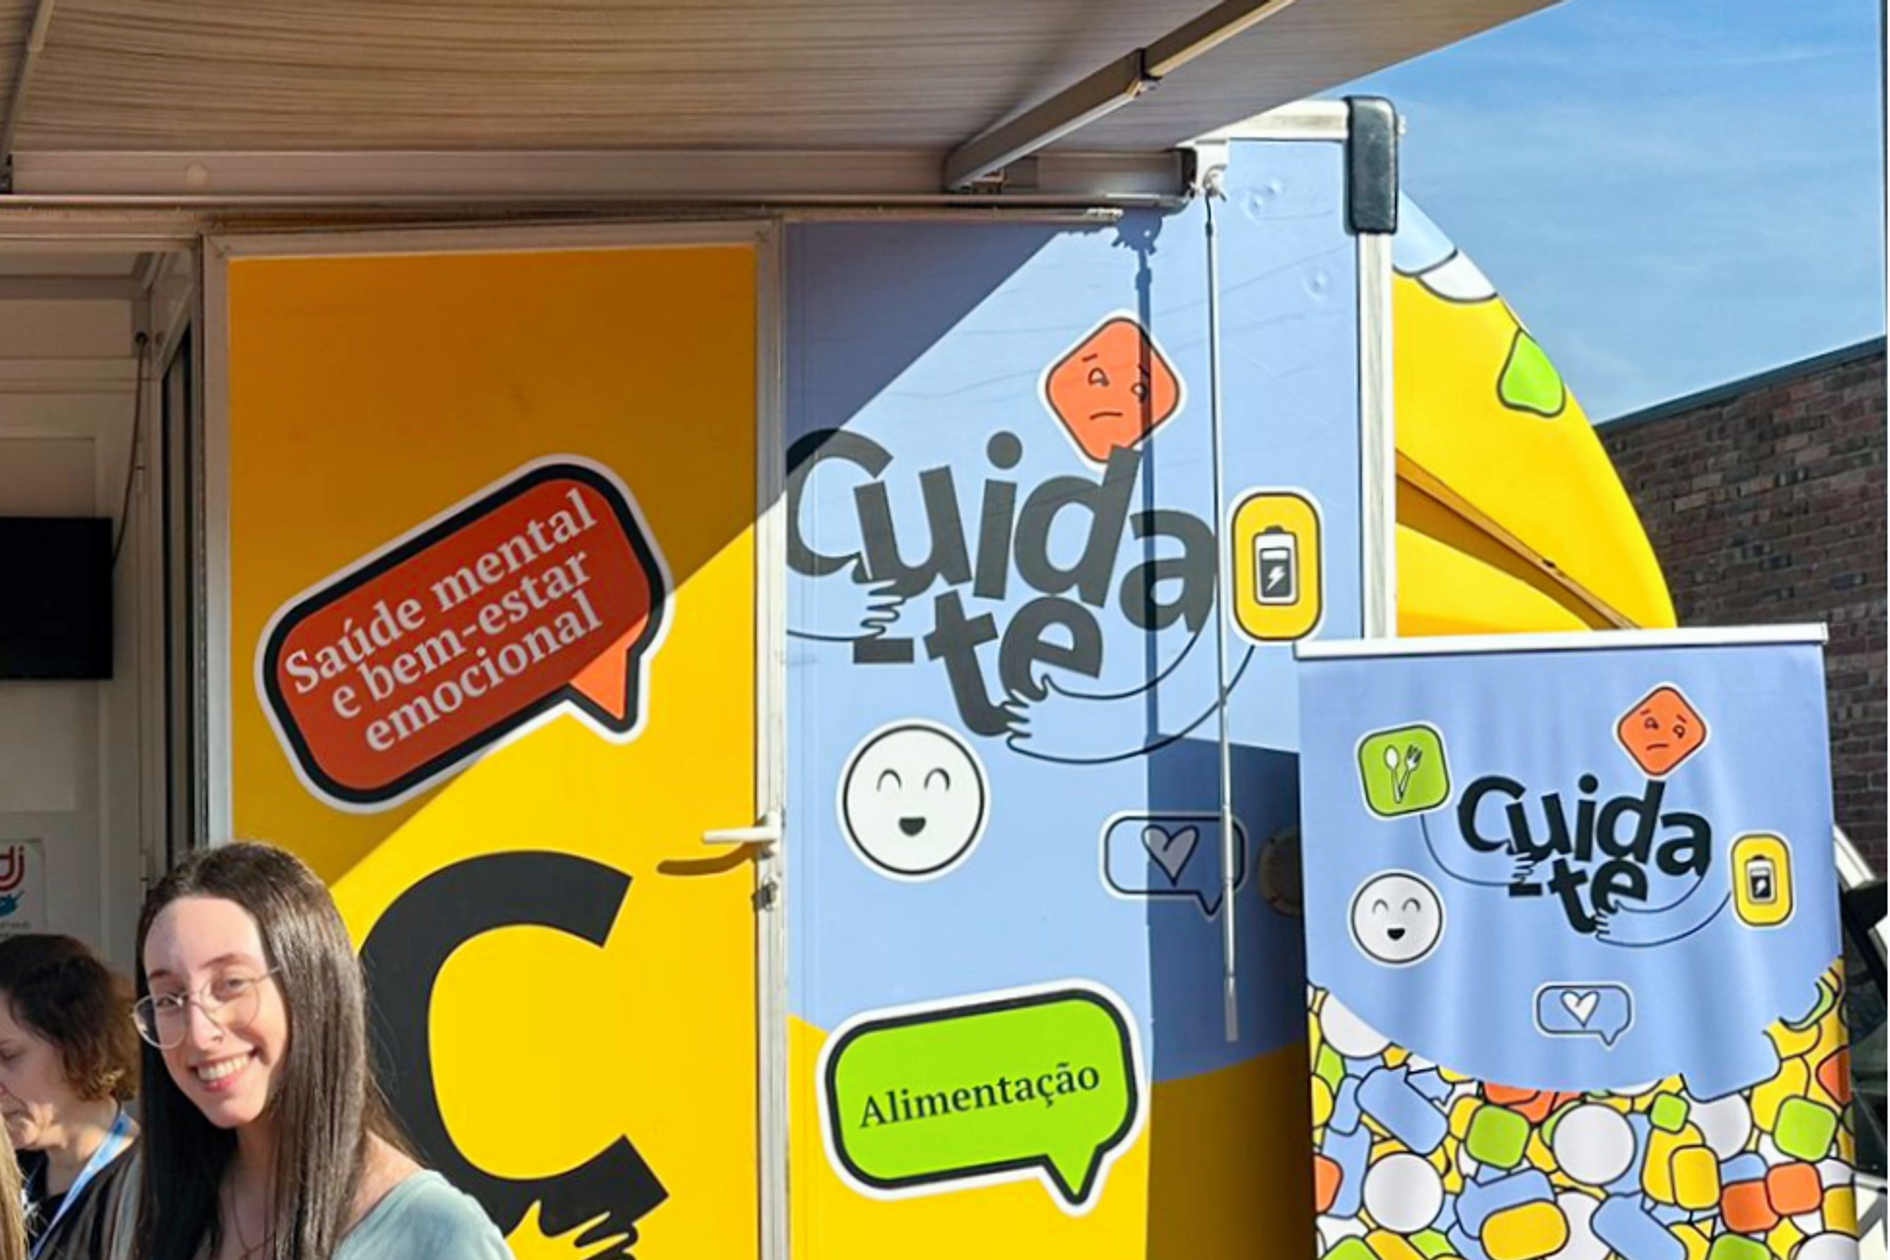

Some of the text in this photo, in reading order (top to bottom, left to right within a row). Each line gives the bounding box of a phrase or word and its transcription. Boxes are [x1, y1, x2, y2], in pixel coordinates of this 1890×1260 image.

[285, 487, 598, 694] Saúde mental
[786, 428, 1219, 634] Cuida
[332, 550, 592, 719] e bem-estar
[363, 591, 604, 752] emocional
[1457, 775, 1712, 877] Cuida
[859, 1062, 1101, 1128] Alimentação
